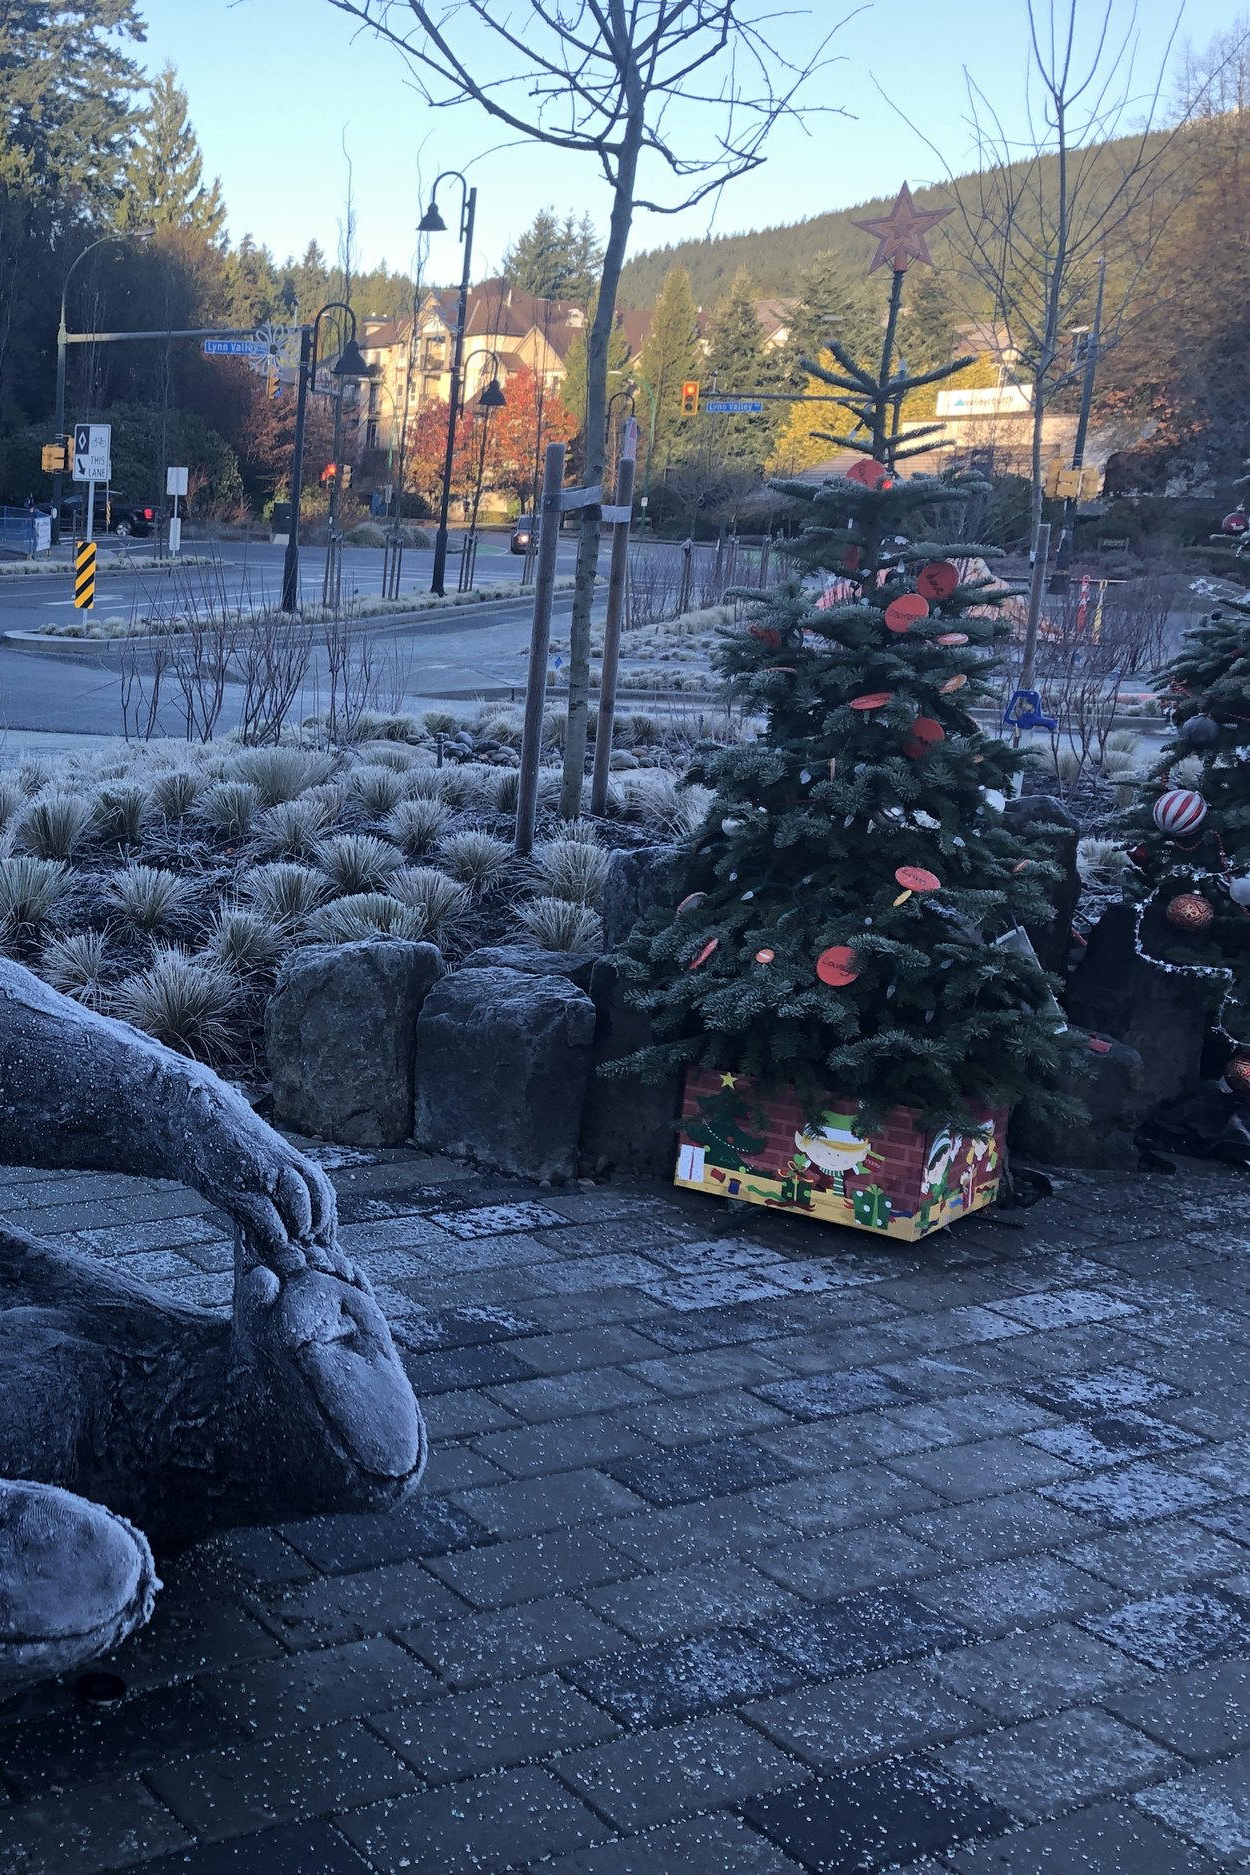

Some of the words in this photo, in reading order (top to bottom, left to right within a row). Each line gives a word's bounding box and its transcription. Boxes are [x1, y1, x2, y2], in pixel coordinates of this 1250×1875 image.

[208, 342, 228, 353] Lynn
[231, 343, 258, 354] Valley
[709, 403, 727, 412] Lynn
[729, 402, 753, 412] Valley
[91, 456, 105, 465] THIS
[88, 468, 105, 477] LANE
